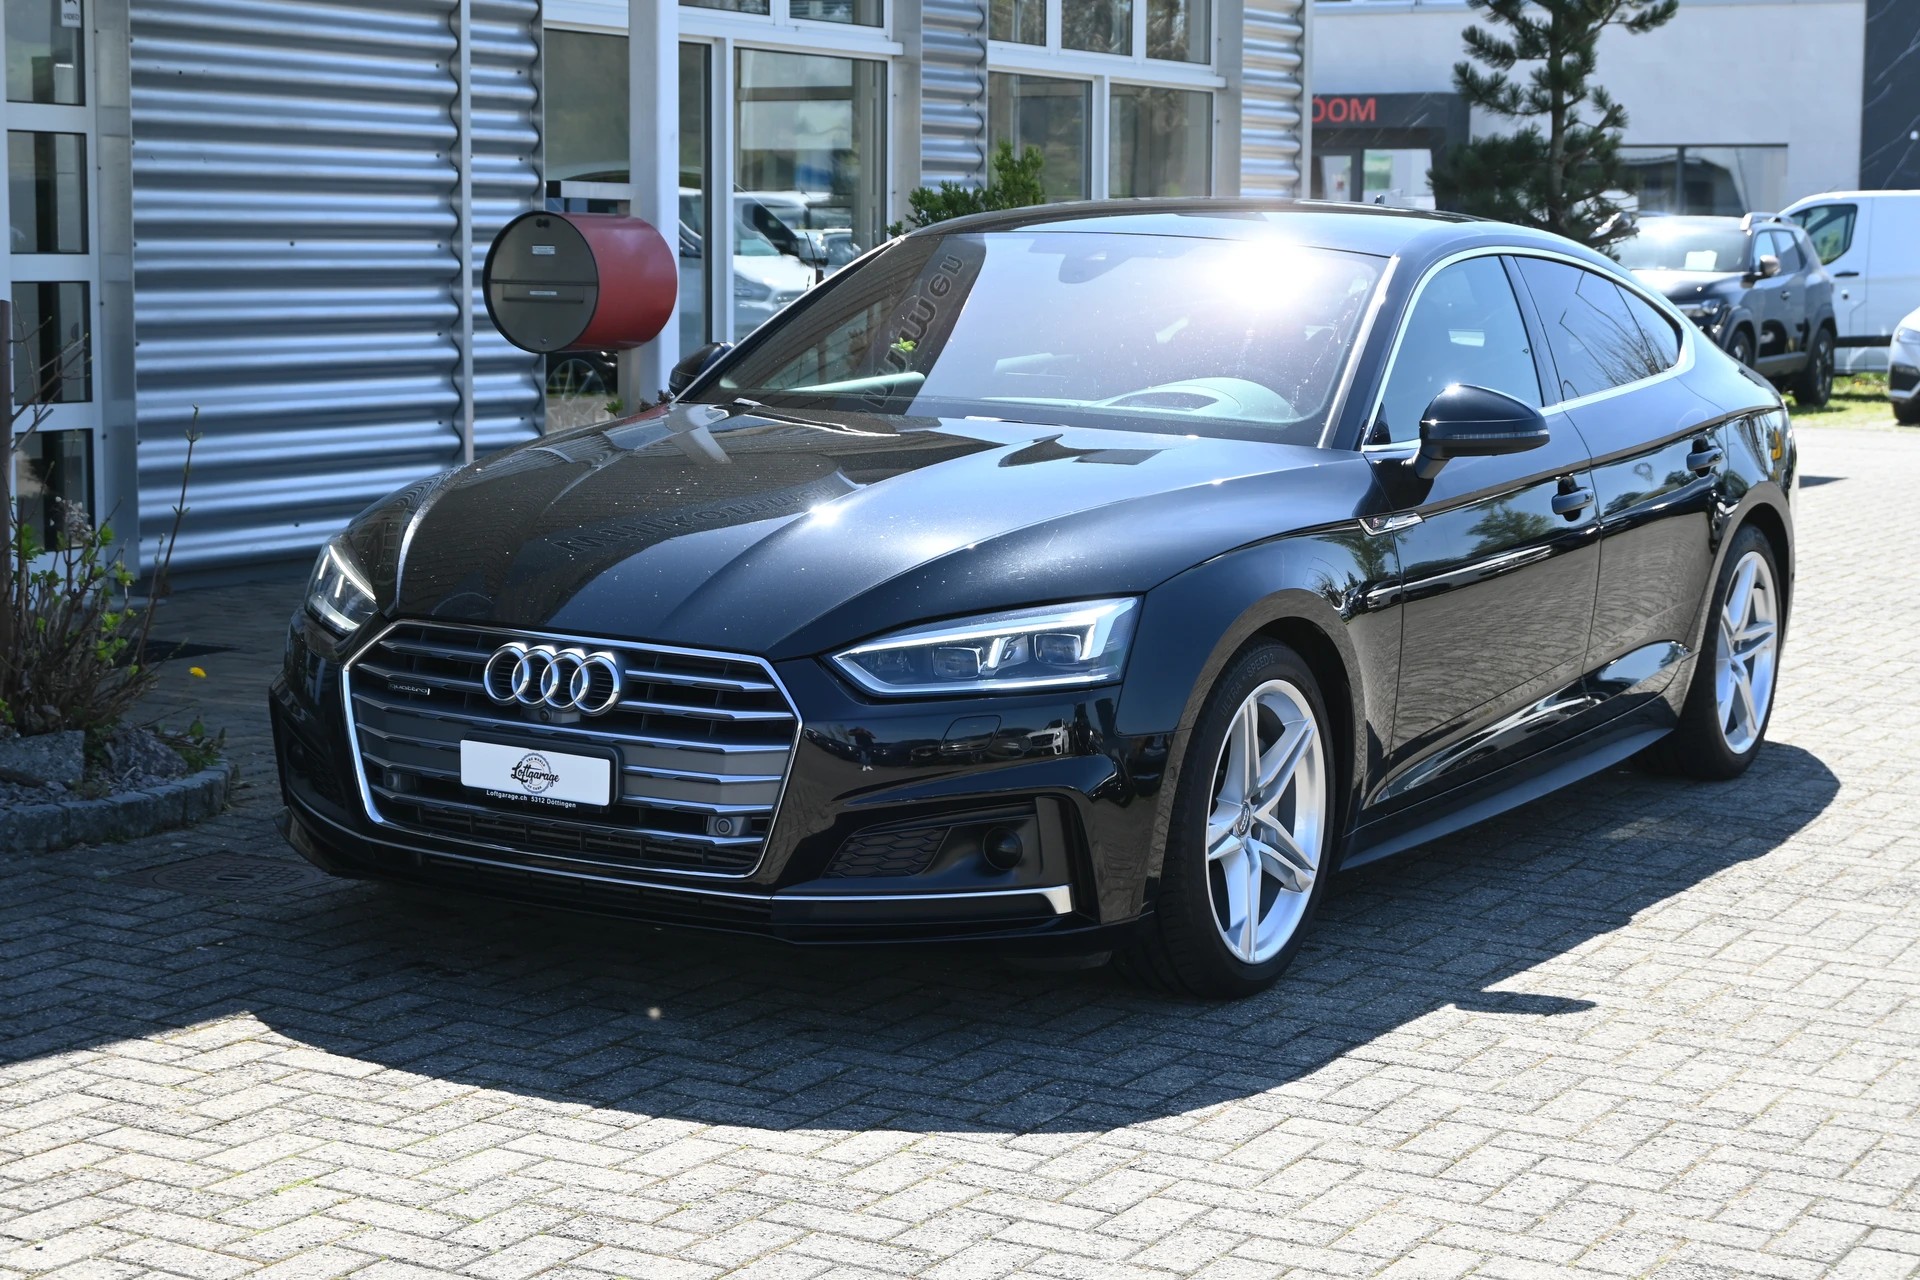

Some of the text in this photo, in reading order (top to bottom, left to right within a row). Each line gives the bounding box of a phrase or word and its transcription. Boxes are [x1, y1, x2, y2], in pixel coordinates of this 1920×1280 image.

[1246, 655, 1270, 678] SPEED
[390, 683, 429, 694] quattro
[511, 761, 559, 787] Loftgarage
[486, 790, 527, 800] Loftgarage.ch
